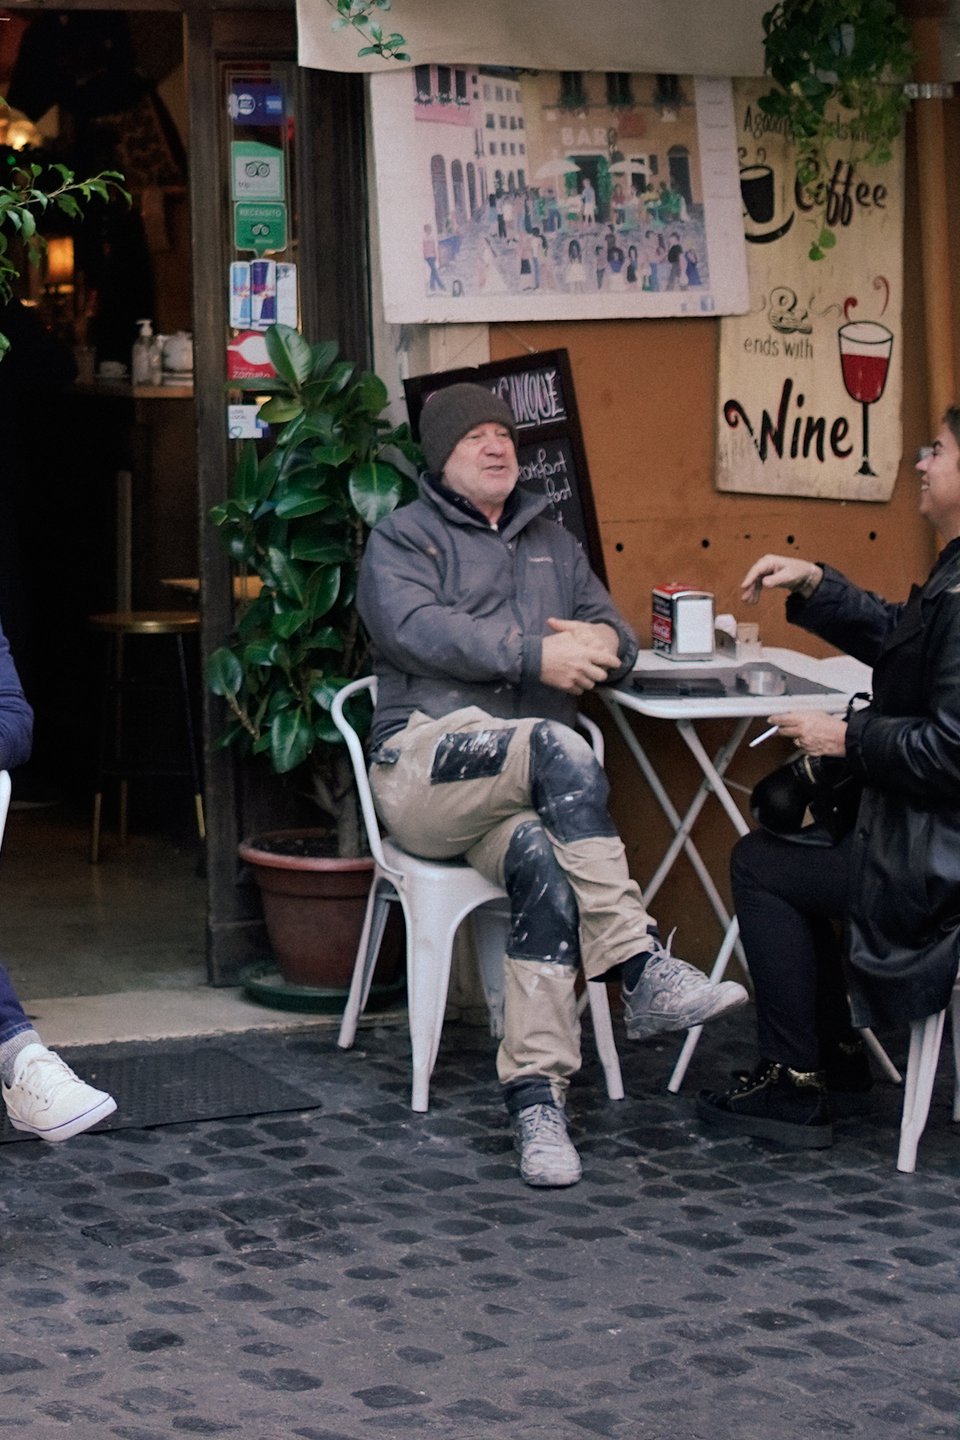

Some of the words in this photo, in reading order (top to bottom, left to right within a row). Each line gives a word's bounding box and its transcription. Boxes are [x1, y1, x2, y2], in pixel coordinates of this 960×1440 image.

[561, 127, 608, 146] BAR
[795, 148, 888, 227] Coffee
[743, 334, 780, 357] ends
[784, 336, 814, 359] with
[723, 377, 853, 464] Wine
